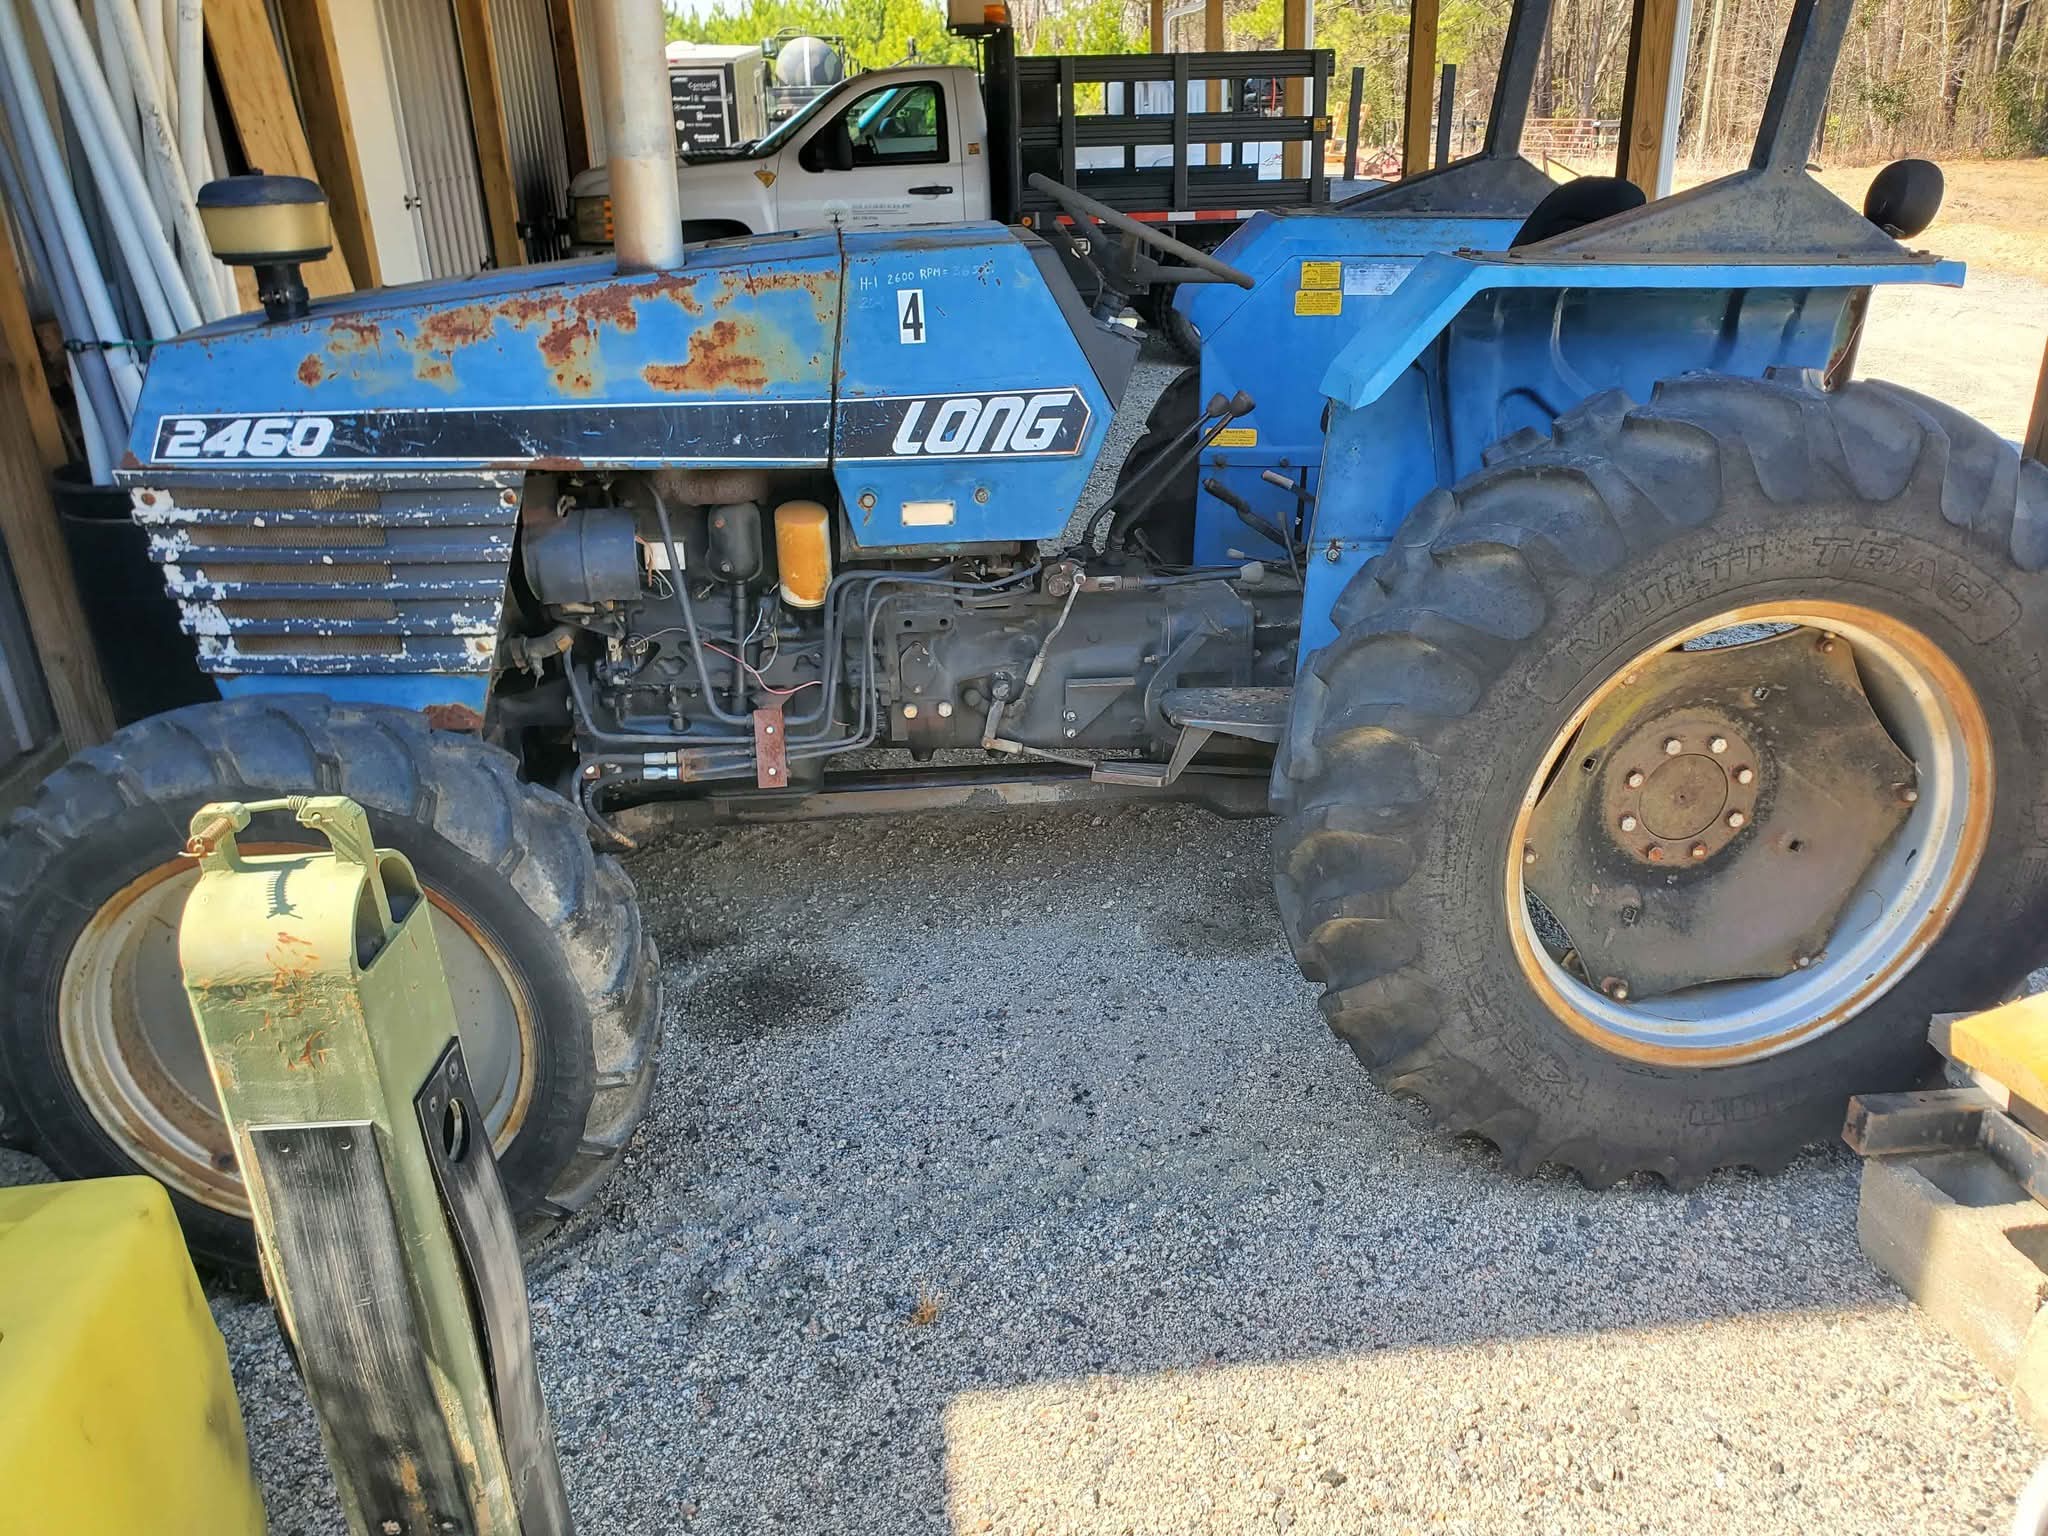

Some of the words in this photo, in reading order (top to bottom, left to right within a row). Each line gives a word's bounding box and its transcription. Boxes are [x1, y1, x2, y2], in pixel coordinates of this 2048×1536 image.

[887, 271, 915, 285] 2600
[902, 291, 924, 342] 4
[164, 416, 335, 458] 2460
[891, 392, 1075, 455] LONG
[1811, 536, 1985, 613] TRAC
